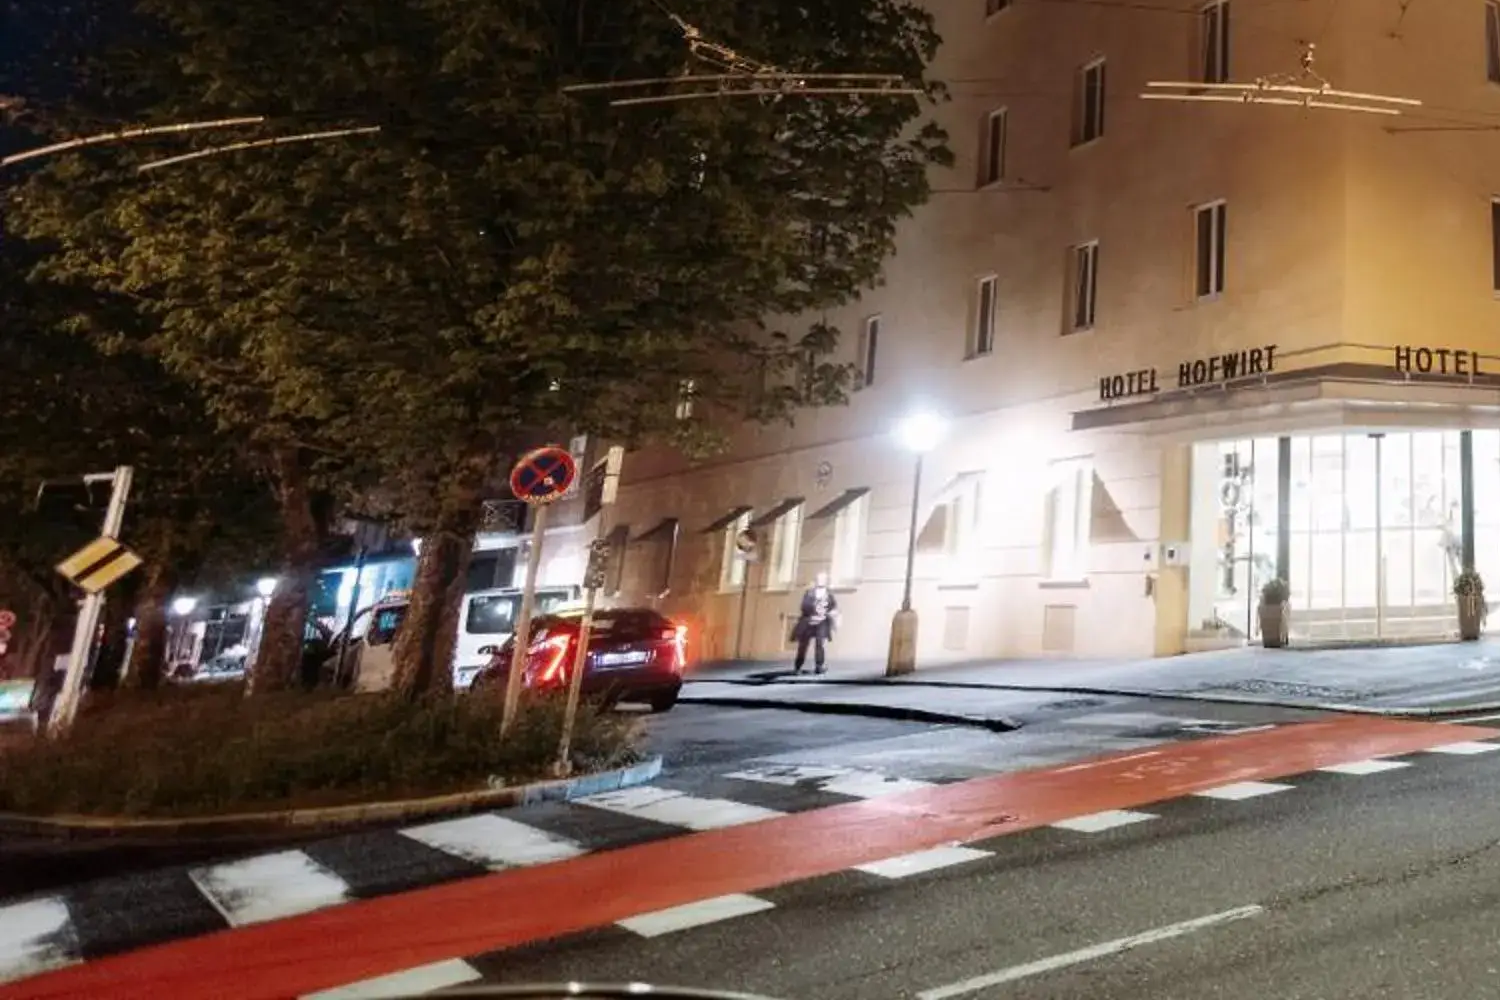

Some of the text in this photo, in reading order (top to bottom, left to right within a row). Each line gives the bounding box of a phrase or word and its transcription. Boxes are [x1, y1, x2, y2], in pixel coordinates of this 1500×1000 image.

[1099, 344, 1277, 401] HOTEL HOFWIRT
[1395, 345, 1484, 376] HOTEL
[1221, 452, 1241, 596] HOTEL
